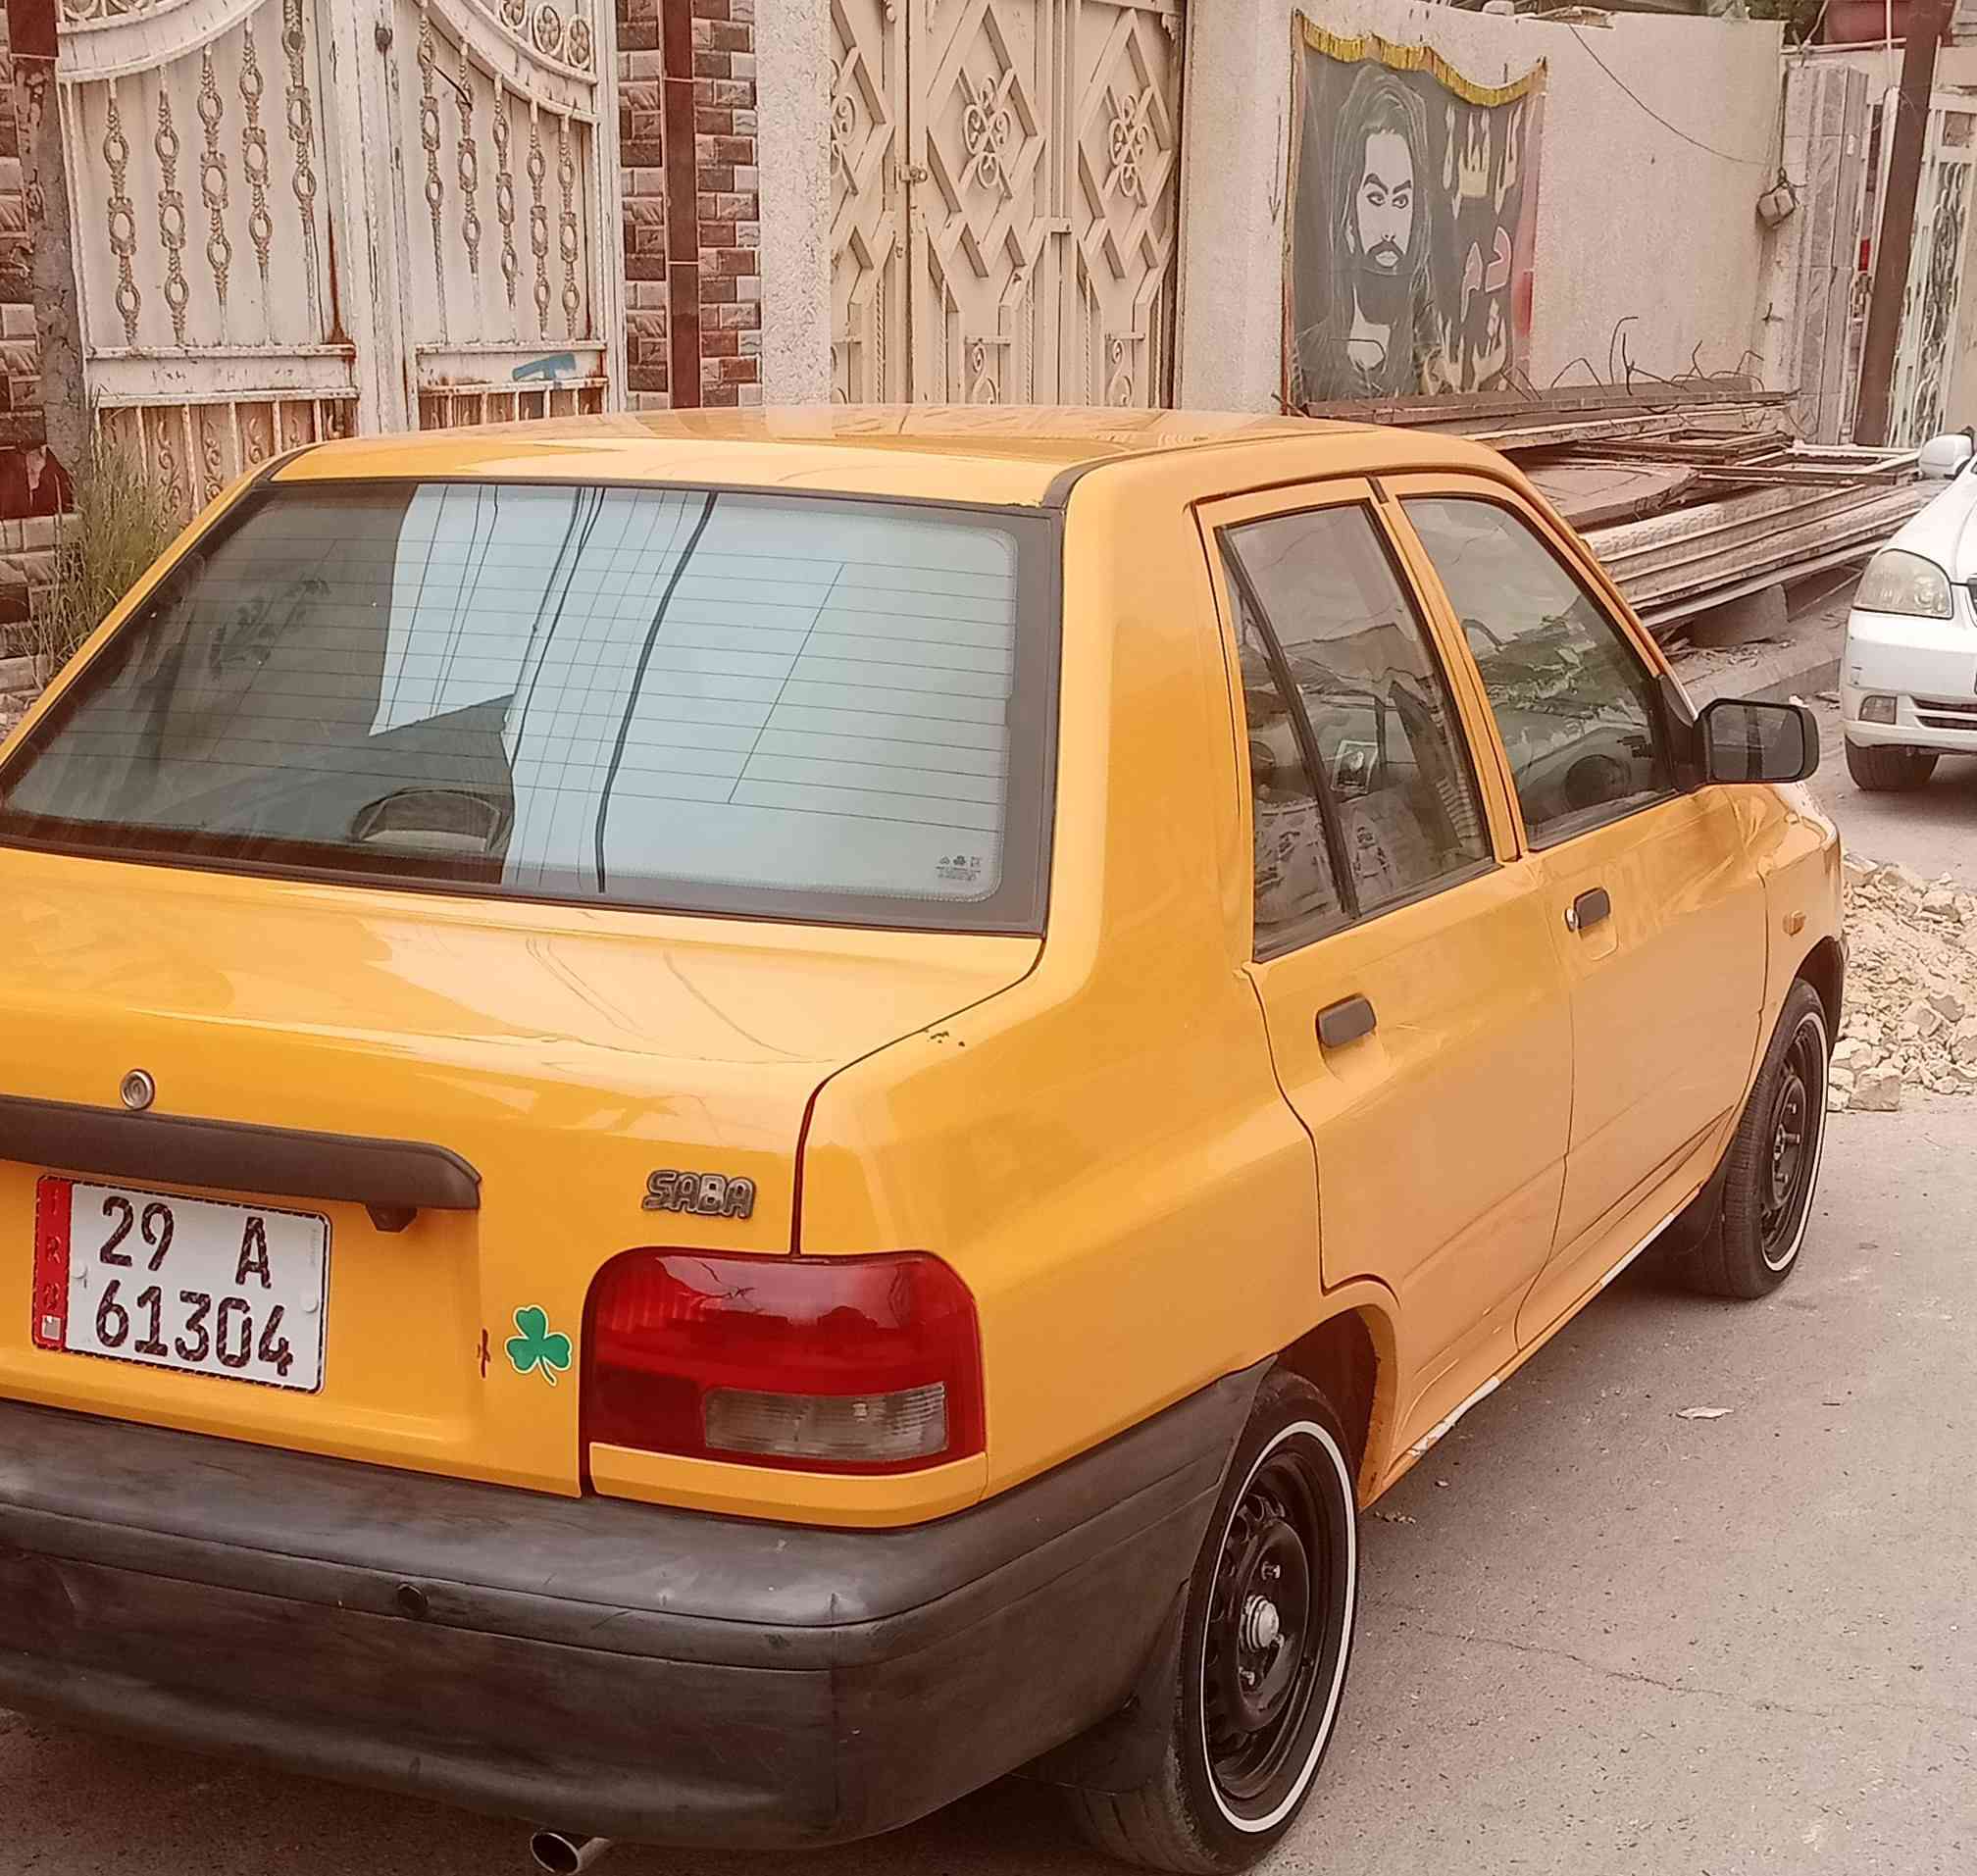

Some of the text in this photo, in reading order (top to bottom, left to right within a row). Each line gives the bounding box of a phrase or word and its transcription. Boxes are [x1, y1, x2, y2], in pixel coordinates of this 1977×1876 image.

[642, 1169, 755, 1219] SABA
[99, 1195, 175, 1271] 29
[235, 1216, 272, 1289] A
[96, 1279, 294, 1377] 61304
